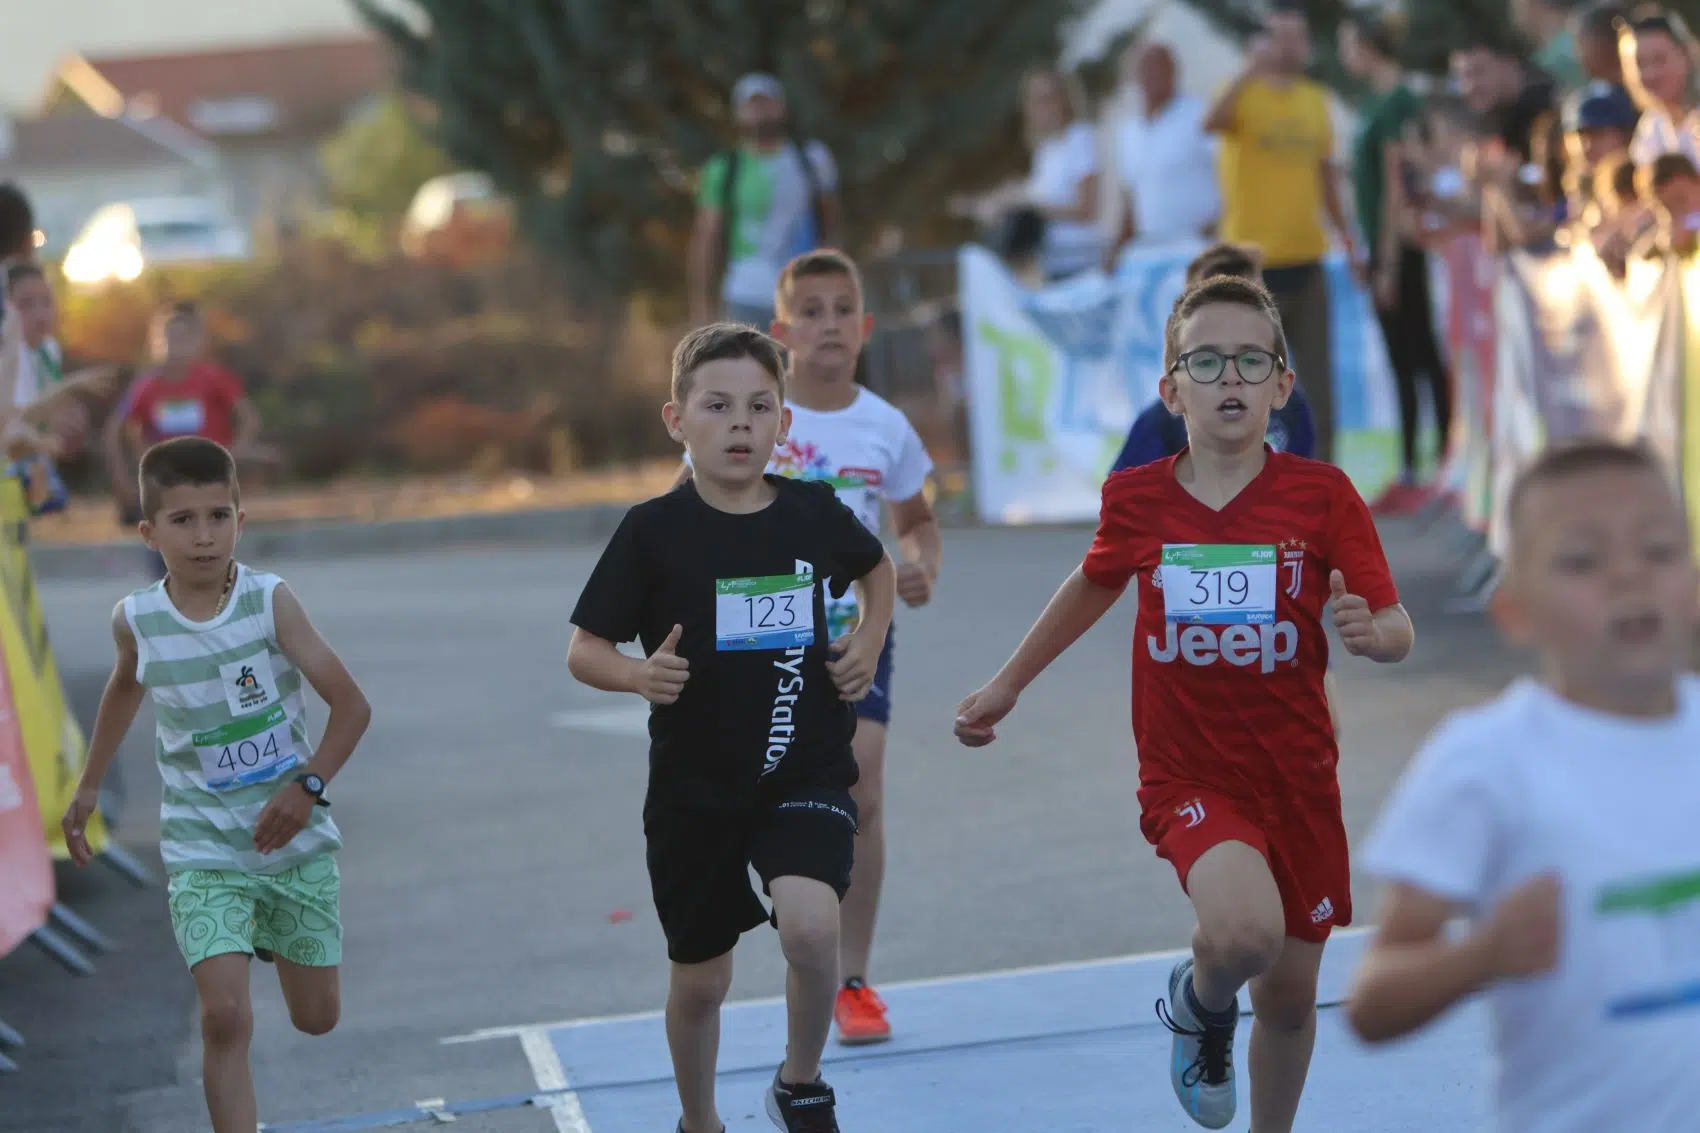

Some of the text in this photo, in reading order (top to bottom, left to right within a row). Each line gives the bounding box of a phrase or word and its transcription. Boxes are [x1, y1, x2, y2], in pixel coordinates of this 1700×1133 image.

[1189, 570, 1249, 605] 319
[744, 594, 796, 628] 123
[1147, 620, 1299, 674] Jeep
[217, 732, 280, 771] 404
